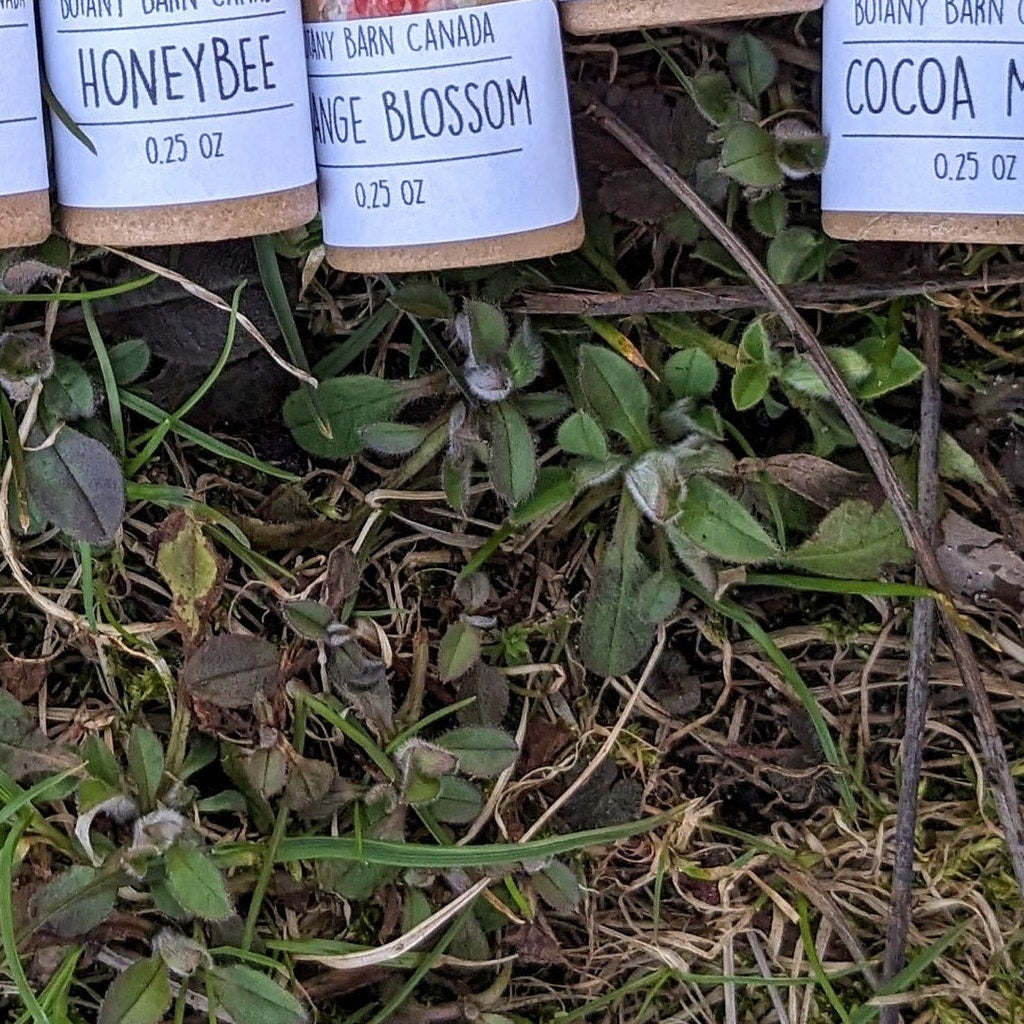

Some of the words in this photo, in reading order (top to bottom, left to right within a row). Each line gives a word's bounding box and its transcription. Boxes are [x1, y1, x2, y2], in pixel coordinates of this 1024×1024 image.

[343, 24, 395, 59] BARN
[406, 11, 496, 53] CANADA
[77, 34, 277, 110] HONEYBEE
[845, 55, 976, 121] COCOA
[312, 92, 367, 145] ANGE
[381, 75, 533, 143] BLOSSOM
[144, 135, 188, 165] 0.25
[198, 132, 225, 160] OZ
[933, 152, 980, 182] 0.25
[991, 154, 1017, 181] OZ
[354, 179, 391, 210] 0.25
[400, 179, 426, 206] OZ
